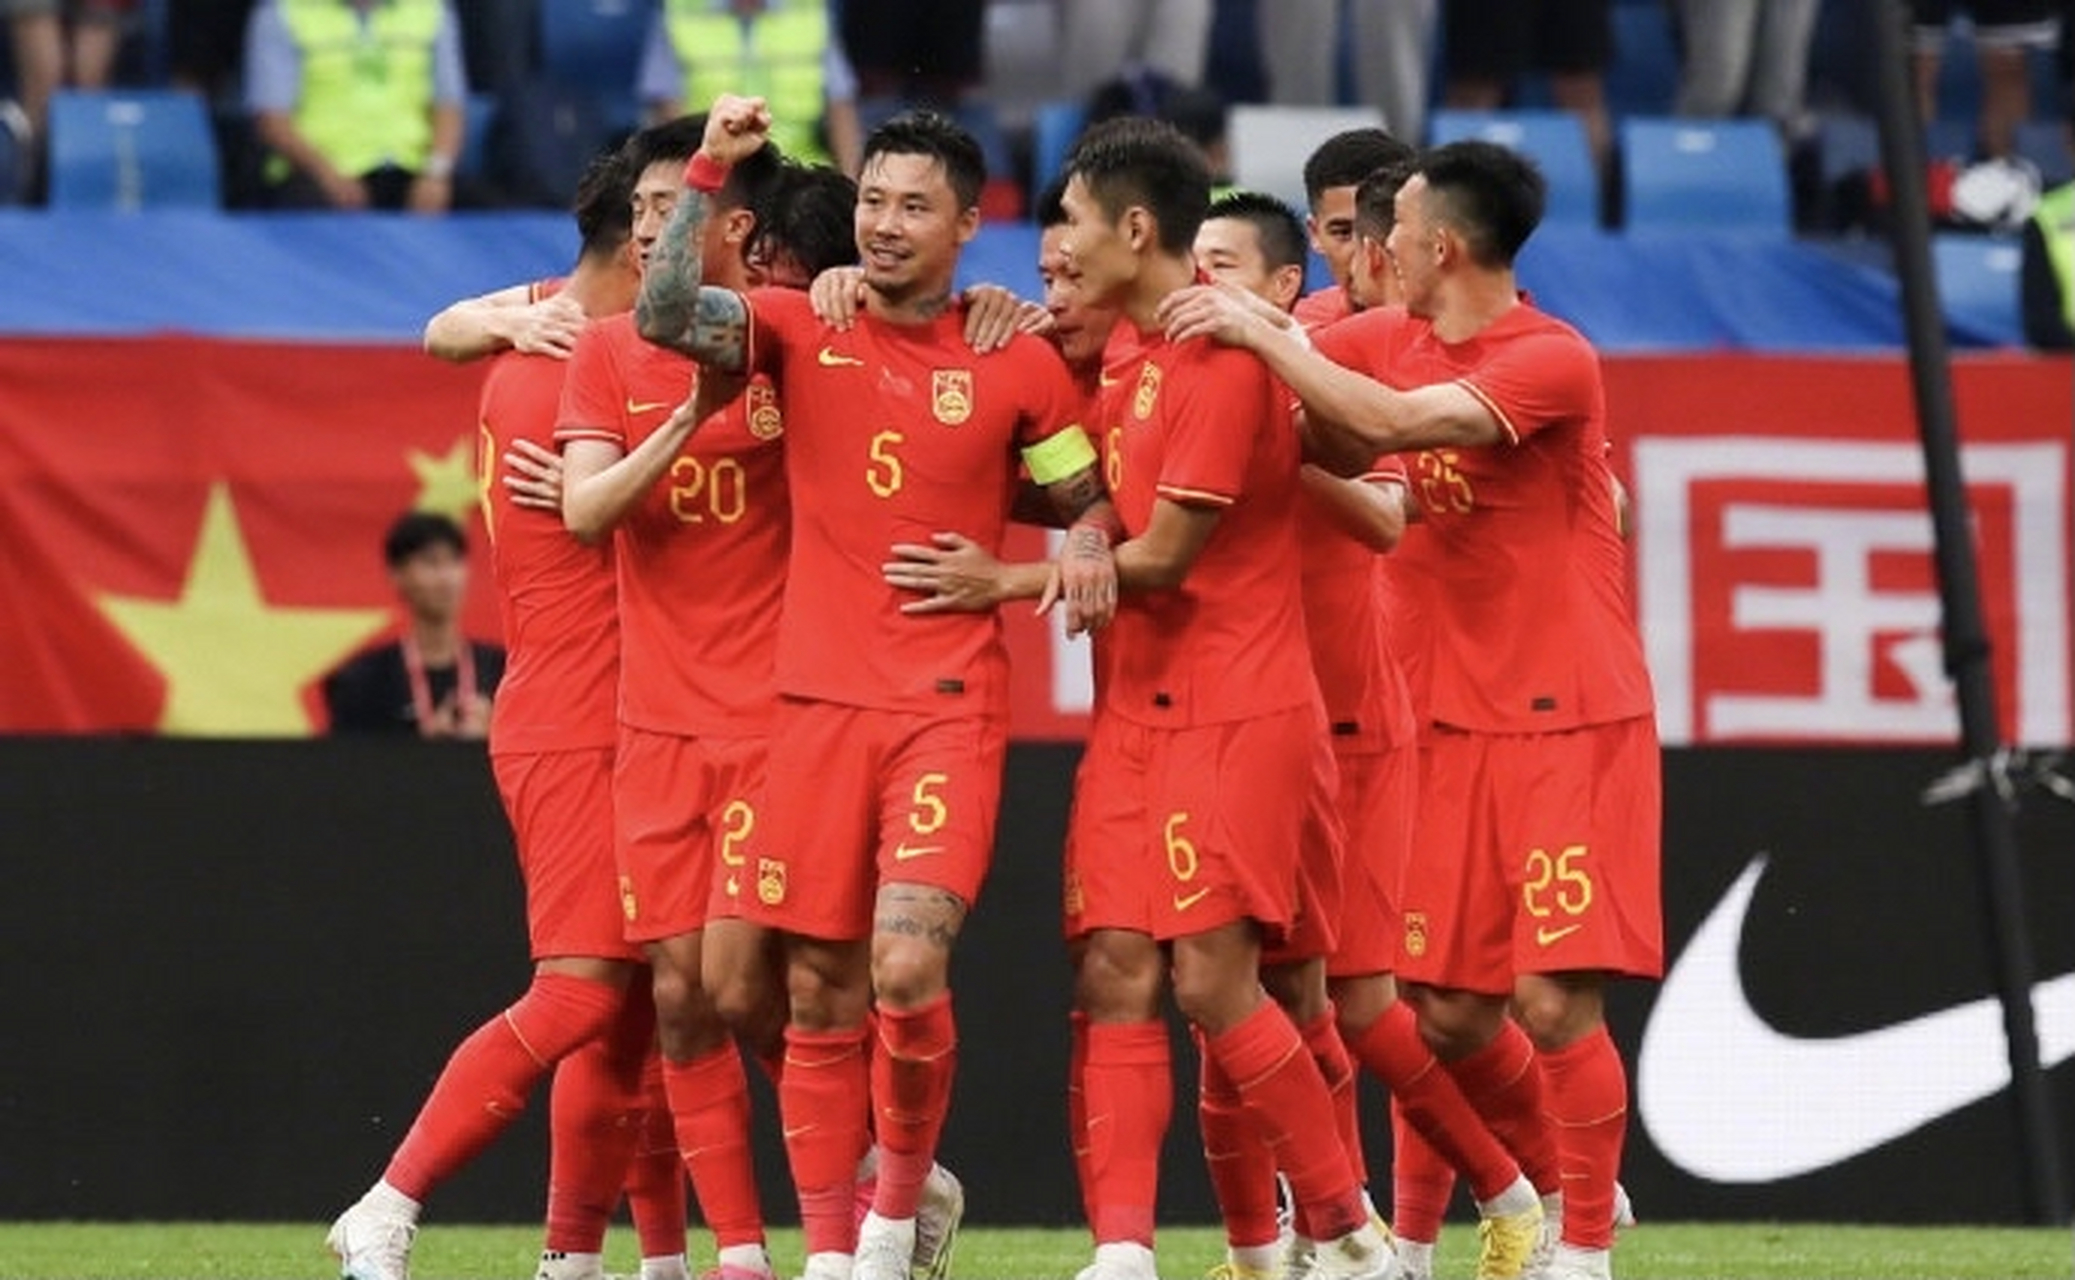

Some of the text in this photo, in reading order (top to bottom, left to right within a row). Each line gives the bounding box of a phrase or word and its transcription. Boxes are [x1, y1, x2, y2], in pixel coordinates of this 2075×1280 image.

[670, 455, 746, 523] 20
[866, 430, 904, 498] 5
[1106, 426, 1124, 512] 6
[1416, 449, 1474, 514] 25
[1631, 436, 2068, 747] 国
[908, 773, 949, 835] 5
[1164, 812, 1198, 882] 6
[1523, 845, 1593, 918] 25
